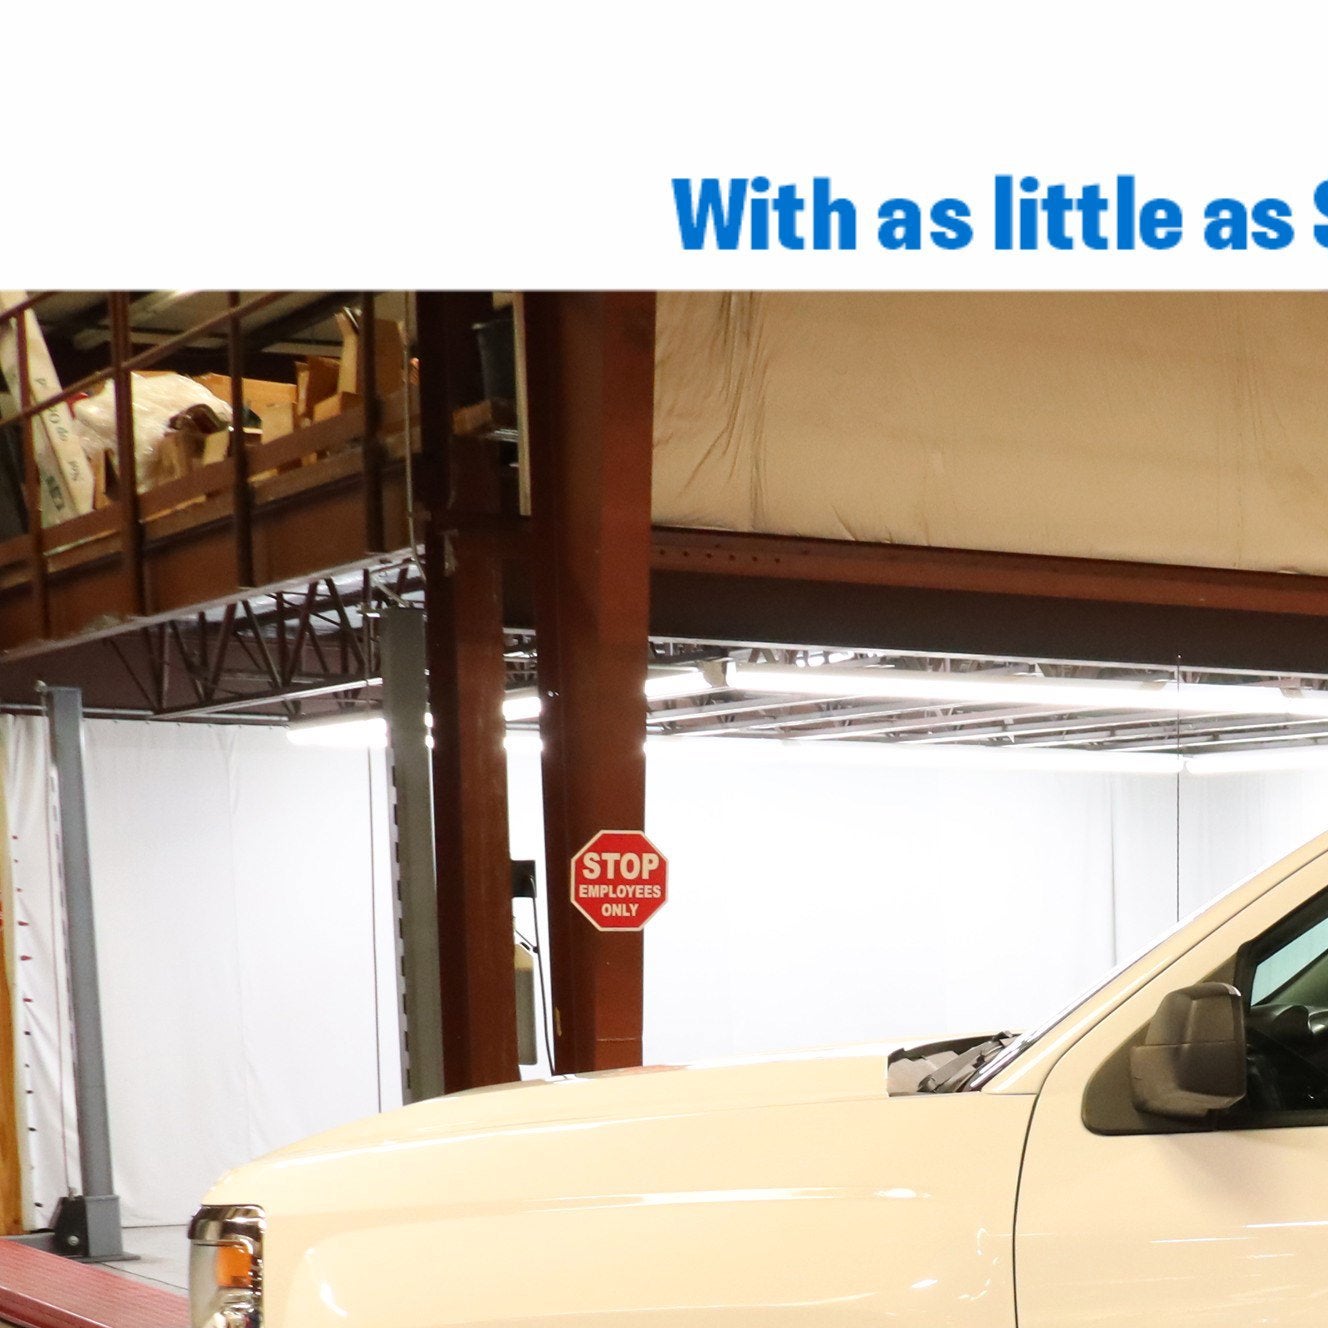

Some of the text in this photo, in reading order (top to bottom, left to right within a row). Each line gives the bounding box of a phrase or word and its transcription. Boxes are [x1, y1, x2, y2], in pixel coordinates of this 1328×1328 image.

[582, 851, 660, 880] STOP
[578, 884, 662, 898] EMPLOYEES
[601, 903, 640, 917] ONLY
